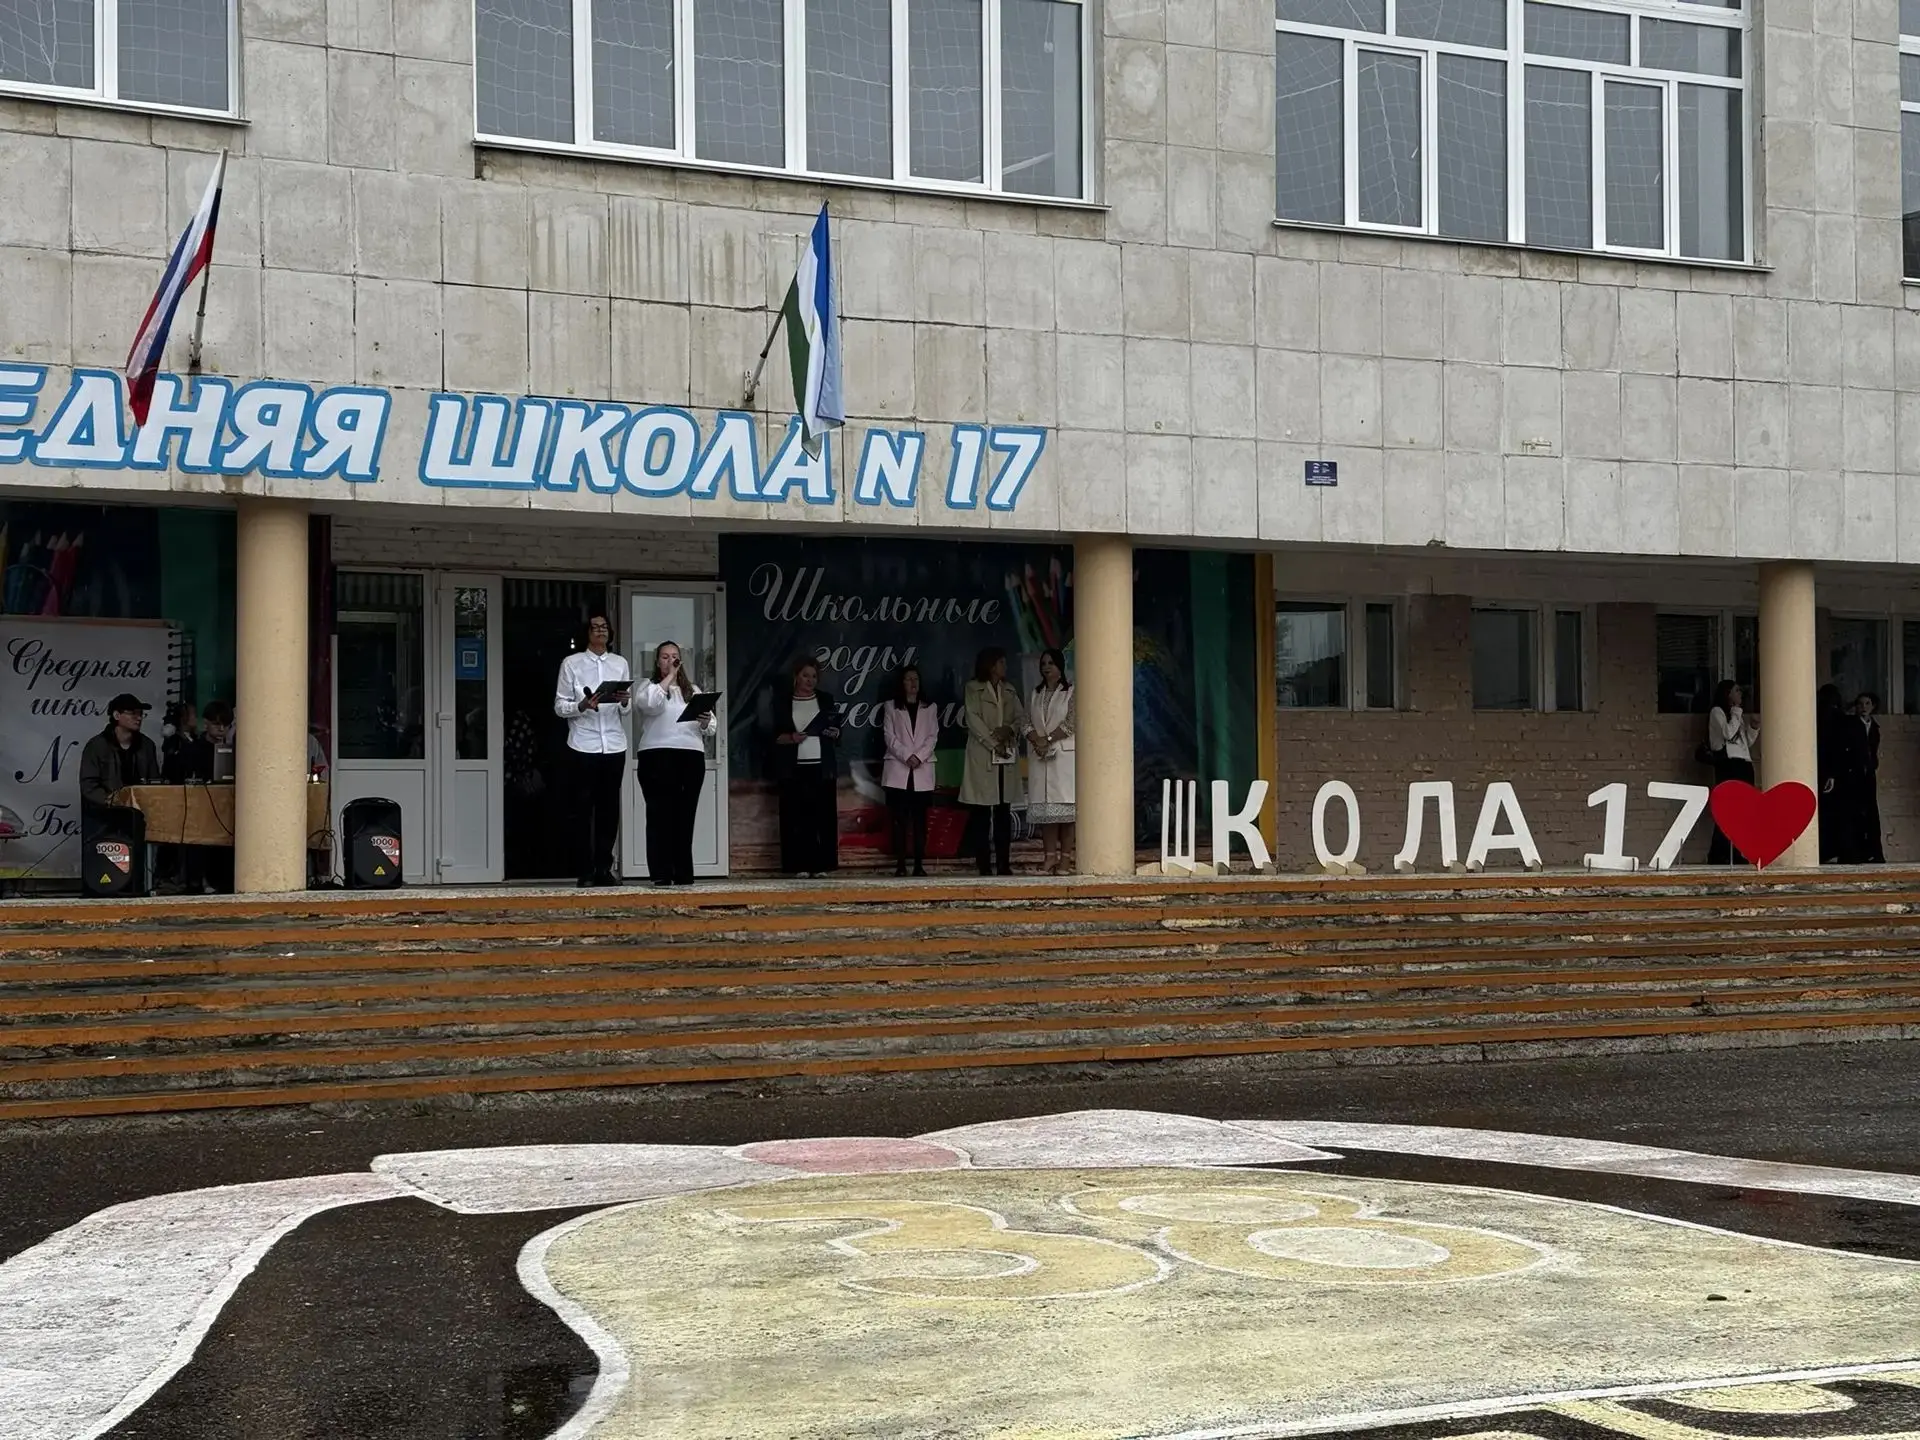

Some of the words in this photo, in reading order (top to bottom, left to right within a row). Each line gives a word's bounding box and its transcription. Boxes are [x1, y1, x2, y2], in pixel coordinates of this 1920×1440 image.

[419, 392, 838, 504] ШКОЛА
[854, 427, 925, 508] N
[946, 423, 1048, 512] 17
[748, 562, 1001, 624] Школьные
[7, 637, 152, 691] Средняя
[96, 844, 121, 853] 1000
[1584, 780, 1711, 870] 17
